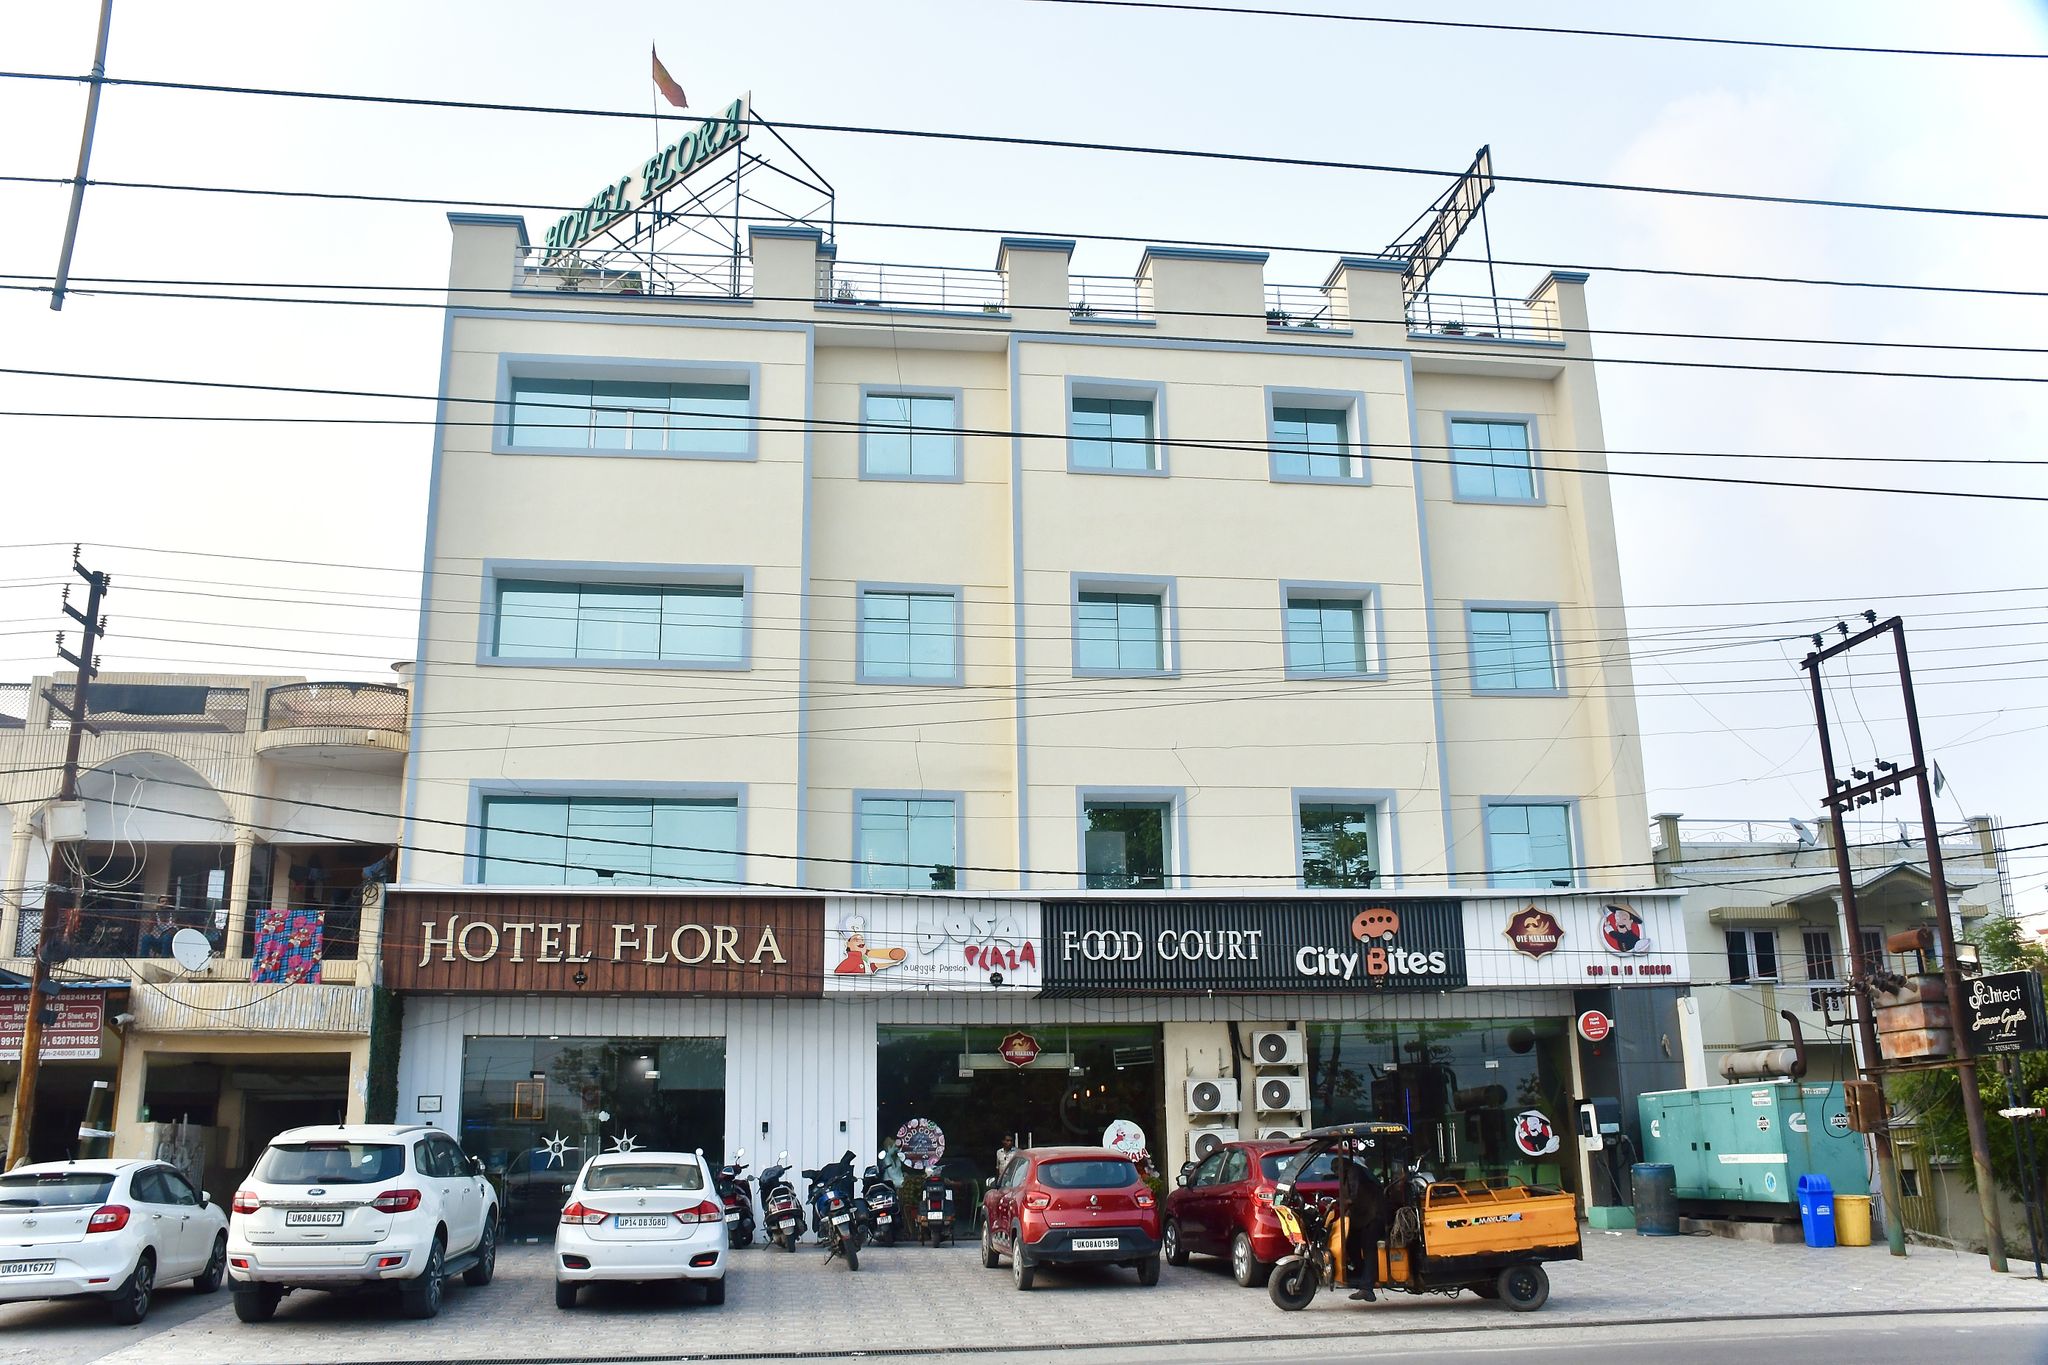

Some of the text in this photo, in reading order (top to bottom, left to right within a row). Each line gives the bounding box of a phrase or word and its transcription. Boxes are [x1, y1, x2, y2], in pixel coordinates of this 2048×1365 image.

[541, 98, 742, 266] HOTEL FLORA
[419, 914, 787, 967] HOTEL FLORA
[964, 940, 1036, 972] PLAZA
[1062, 929, 1262, 961] FOOD COURT
[1295, 945, 1447, 981] City Bites
